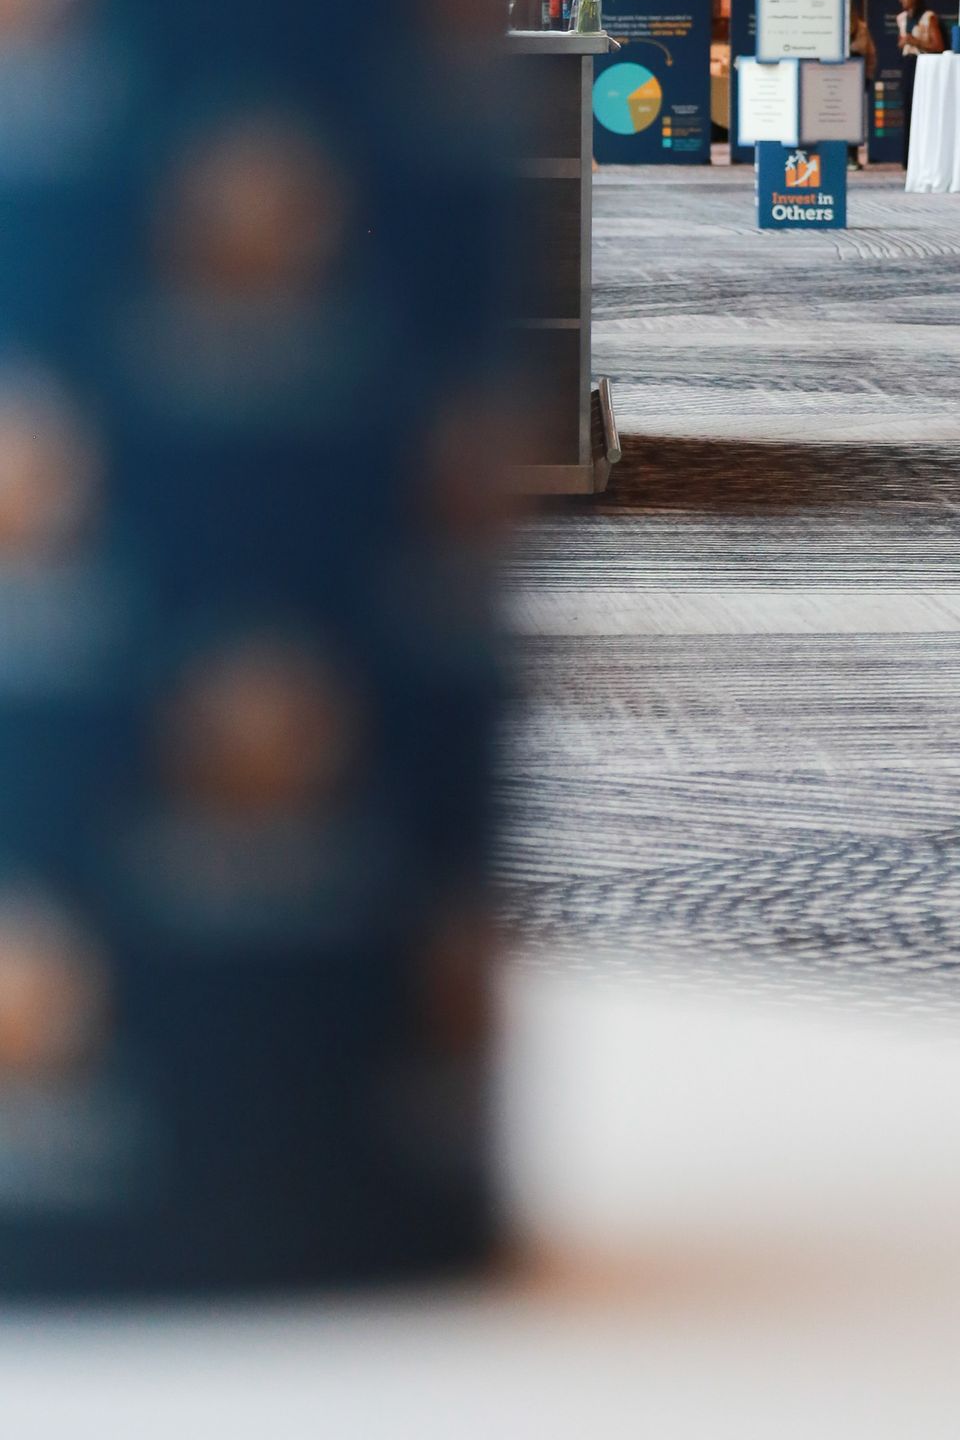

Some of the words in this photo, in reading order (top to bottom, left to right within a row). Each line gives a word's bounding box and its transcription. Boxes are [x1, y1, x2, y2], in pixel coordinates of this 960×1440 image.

[772, 192, 816, 205] Invest
[818, 192, 834, 205] in
[771, 205, 834, 221] Others
